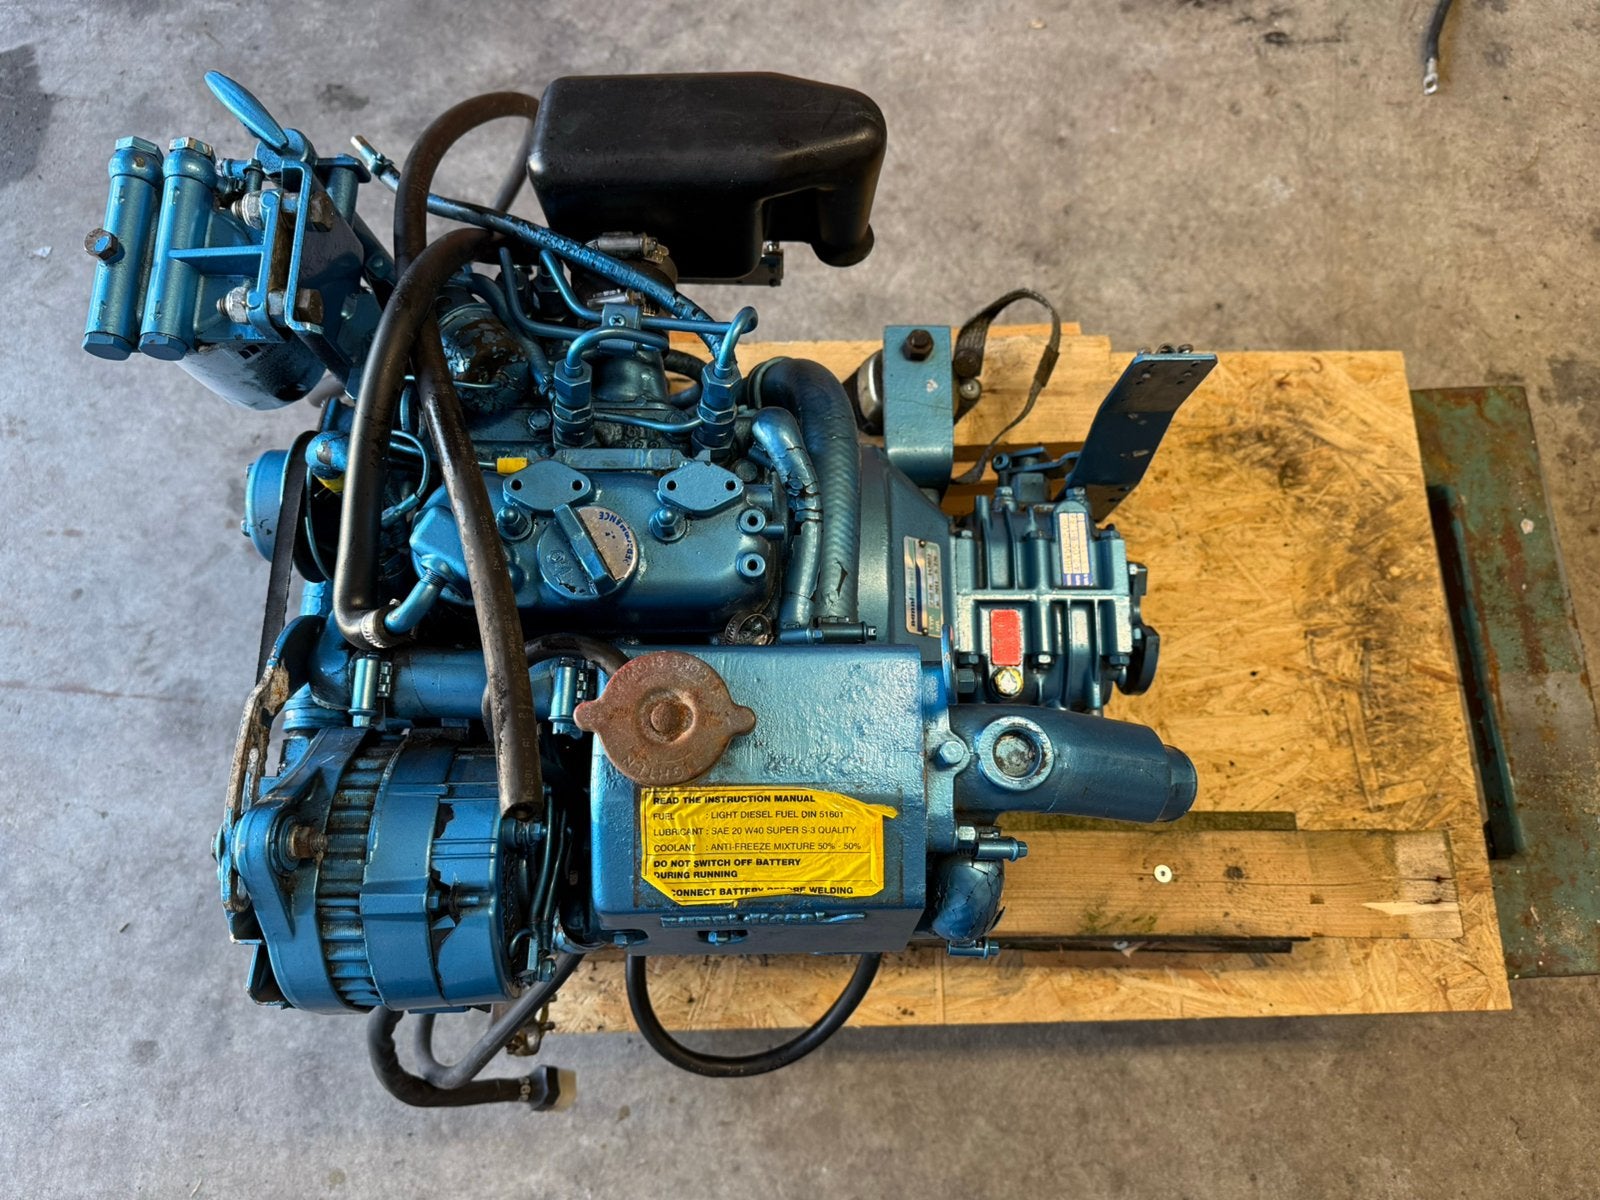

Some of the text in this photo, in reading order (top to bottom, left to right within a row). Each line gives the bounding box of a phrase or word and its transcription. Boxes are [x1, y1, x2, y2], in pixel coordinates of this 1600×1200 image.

[653, 794, 816, 805] READ THE INSTRUCTION MANUAL
[653, 812, 675, 821] FUEL
[711, 810, 738, 819] LIGHT
[740, 810, 773, 819] DIESEL
[775, 810, 799, 818] FUEL
[801, 810, 817, 819] DIN
[819, 810, 844, 818] 51601
[653, 827, 704, 837] LUBRICANT
[711, 827, 729, 836] SAE
[731, 827, 742, 835] 20
[745, 826, 764, 835] W40
[766, 825, 799, 834] SUPER
[801, 825, 816, 834] S-3
[817, 825, 857, 834] QUALITY
[653, 843, 697, 853] COOLANT
[710, 842, 771, 851] ANTI-FREEZE
[773, 842, 816, 851] MIXTURE
[817, 842, 836, 850] 50%
[843, 842, 862, 850] 50%
[653, 857, 802, 868] DO NOT SWITCH OFF BATTERY
[653, 869, 738, 880] DURING RUNNING
[808, 886, 854, 895] WELDING
